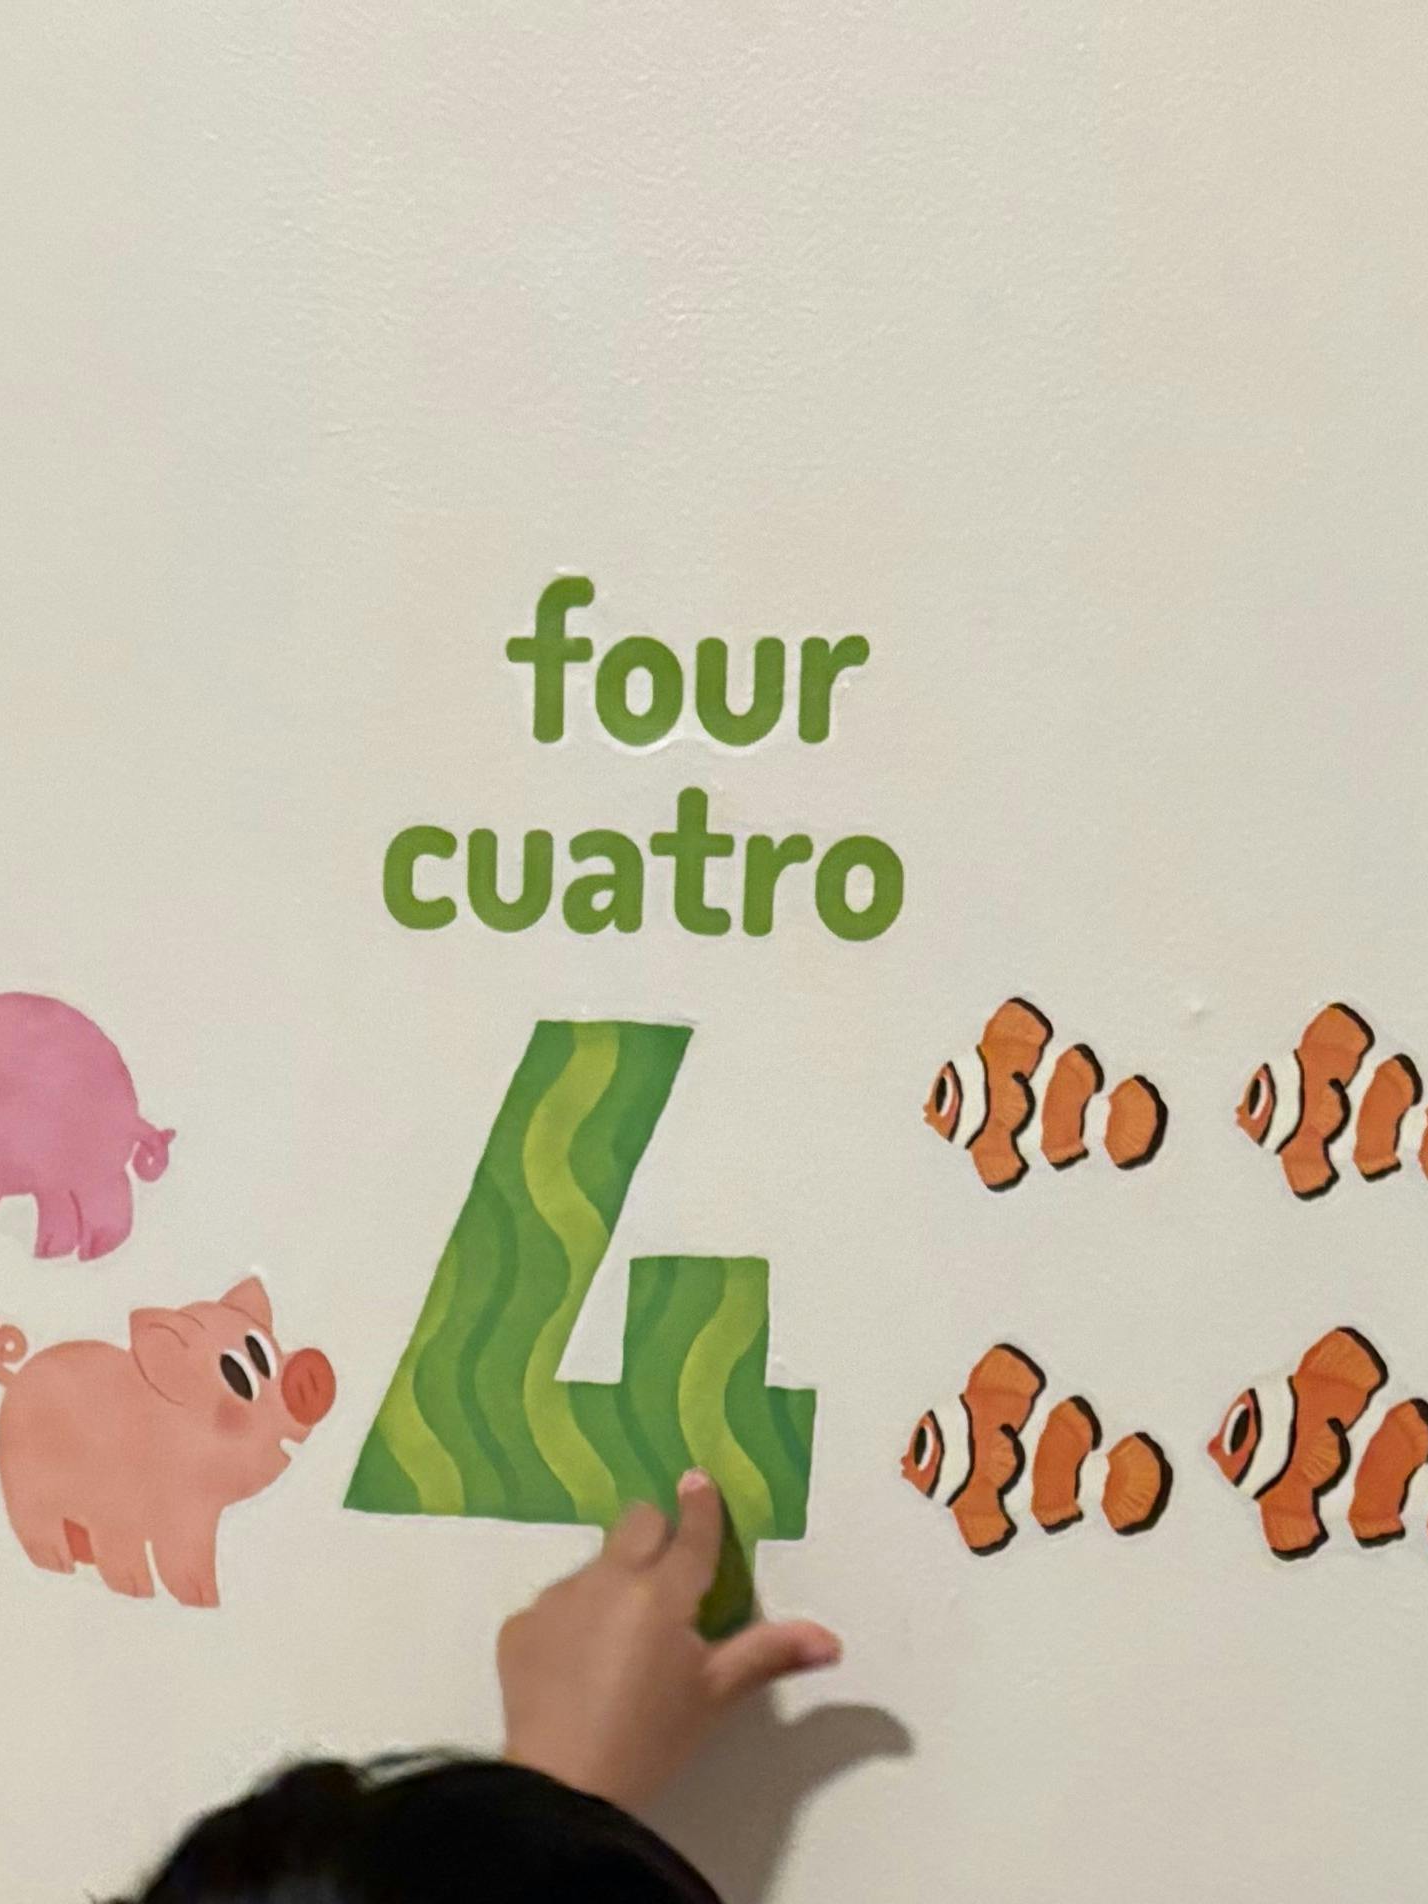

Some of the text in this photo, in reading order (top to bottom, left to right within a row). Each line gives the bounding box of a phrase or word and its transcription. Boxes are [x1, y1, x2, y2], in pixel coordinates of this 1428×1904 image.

[504, 575, 871, 747] four
[382, 786, 905, 942] cuatro
[342, 1020, 818, 1638] 4
